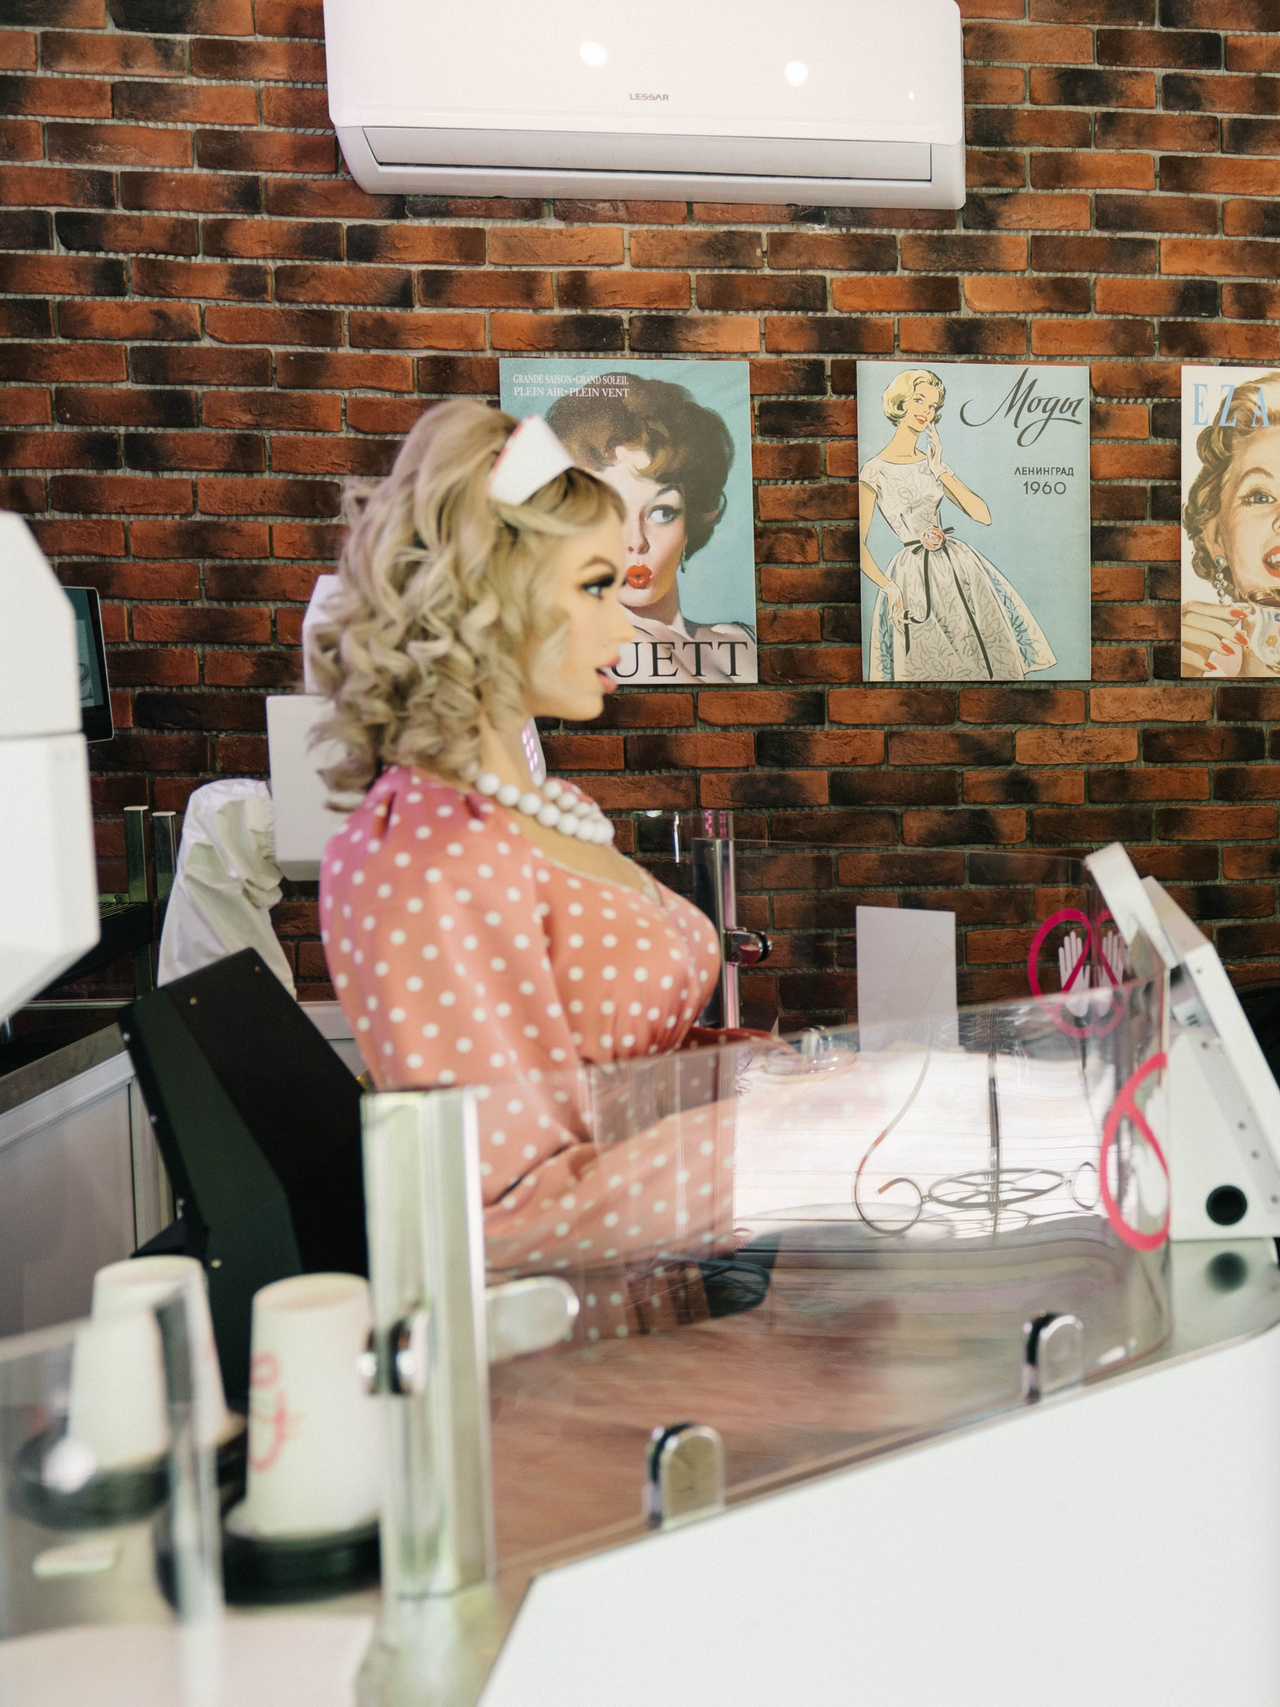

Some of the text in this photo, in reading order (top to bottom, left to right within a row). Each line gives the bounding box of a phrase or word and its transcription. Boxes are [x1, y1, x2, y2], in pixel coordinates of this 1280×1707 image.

[629, 93, 669, 101] LESSAR
[513, 374, 544, 384] GRANDE
[602, 375, 629, 385] SOLEIL
[514, 386, 544, 396] PLEIN
[602, 388, 630, 398] VENT
[1014, 466, 1074, 477] ЛЕНИНГРАД
[1023, 481, 1067, 495] 1960
